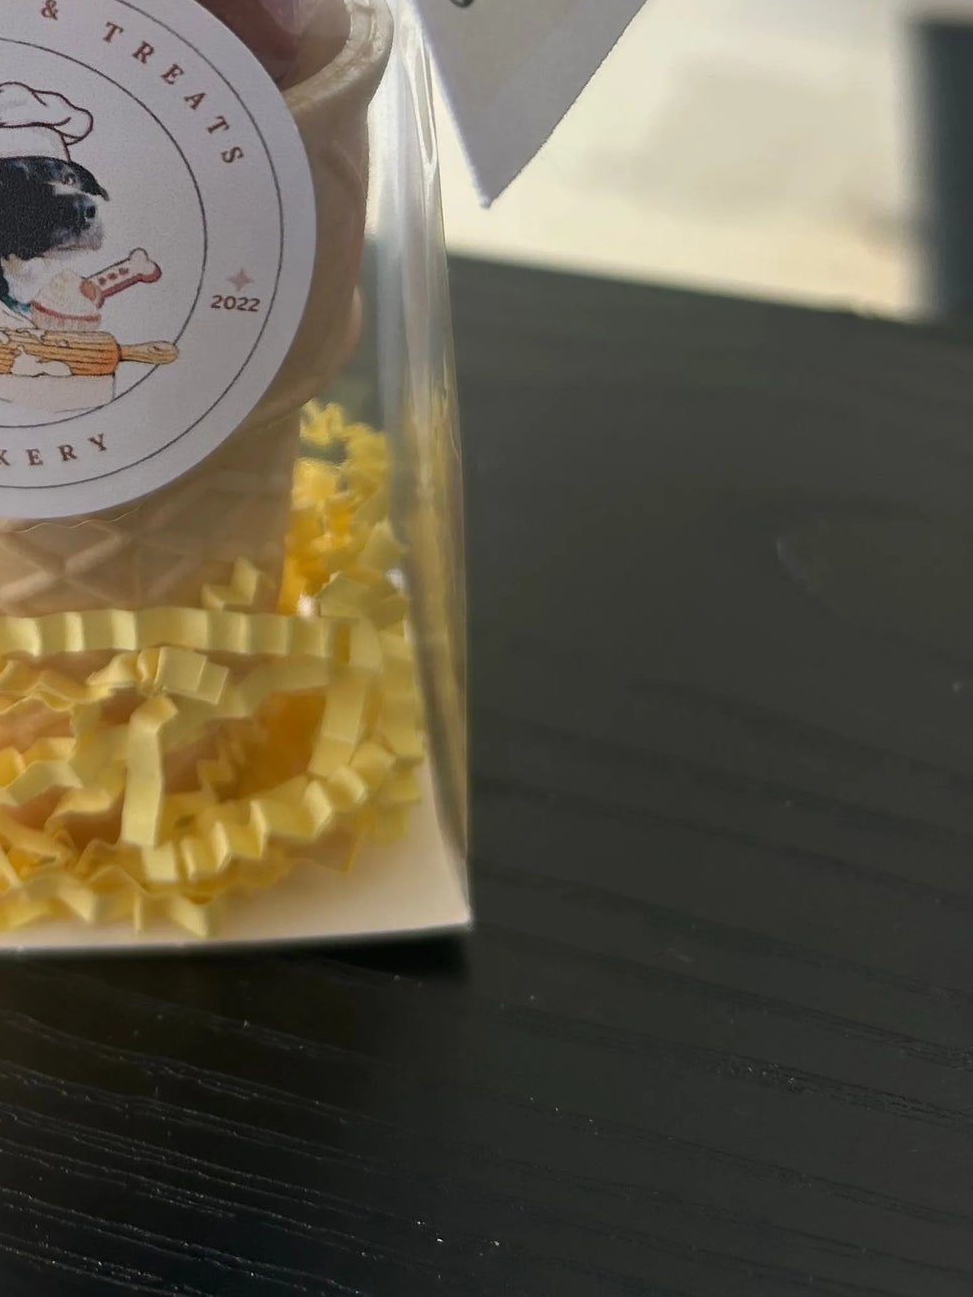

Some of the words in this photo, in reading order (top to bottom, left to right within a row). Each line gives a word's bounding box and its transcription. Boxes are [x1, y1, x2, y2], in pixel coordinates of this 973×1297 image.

[41, 0, 60, 21] &
[101, 21, 245, 167] TREATS
[210, 293, 261, 313] 2022
